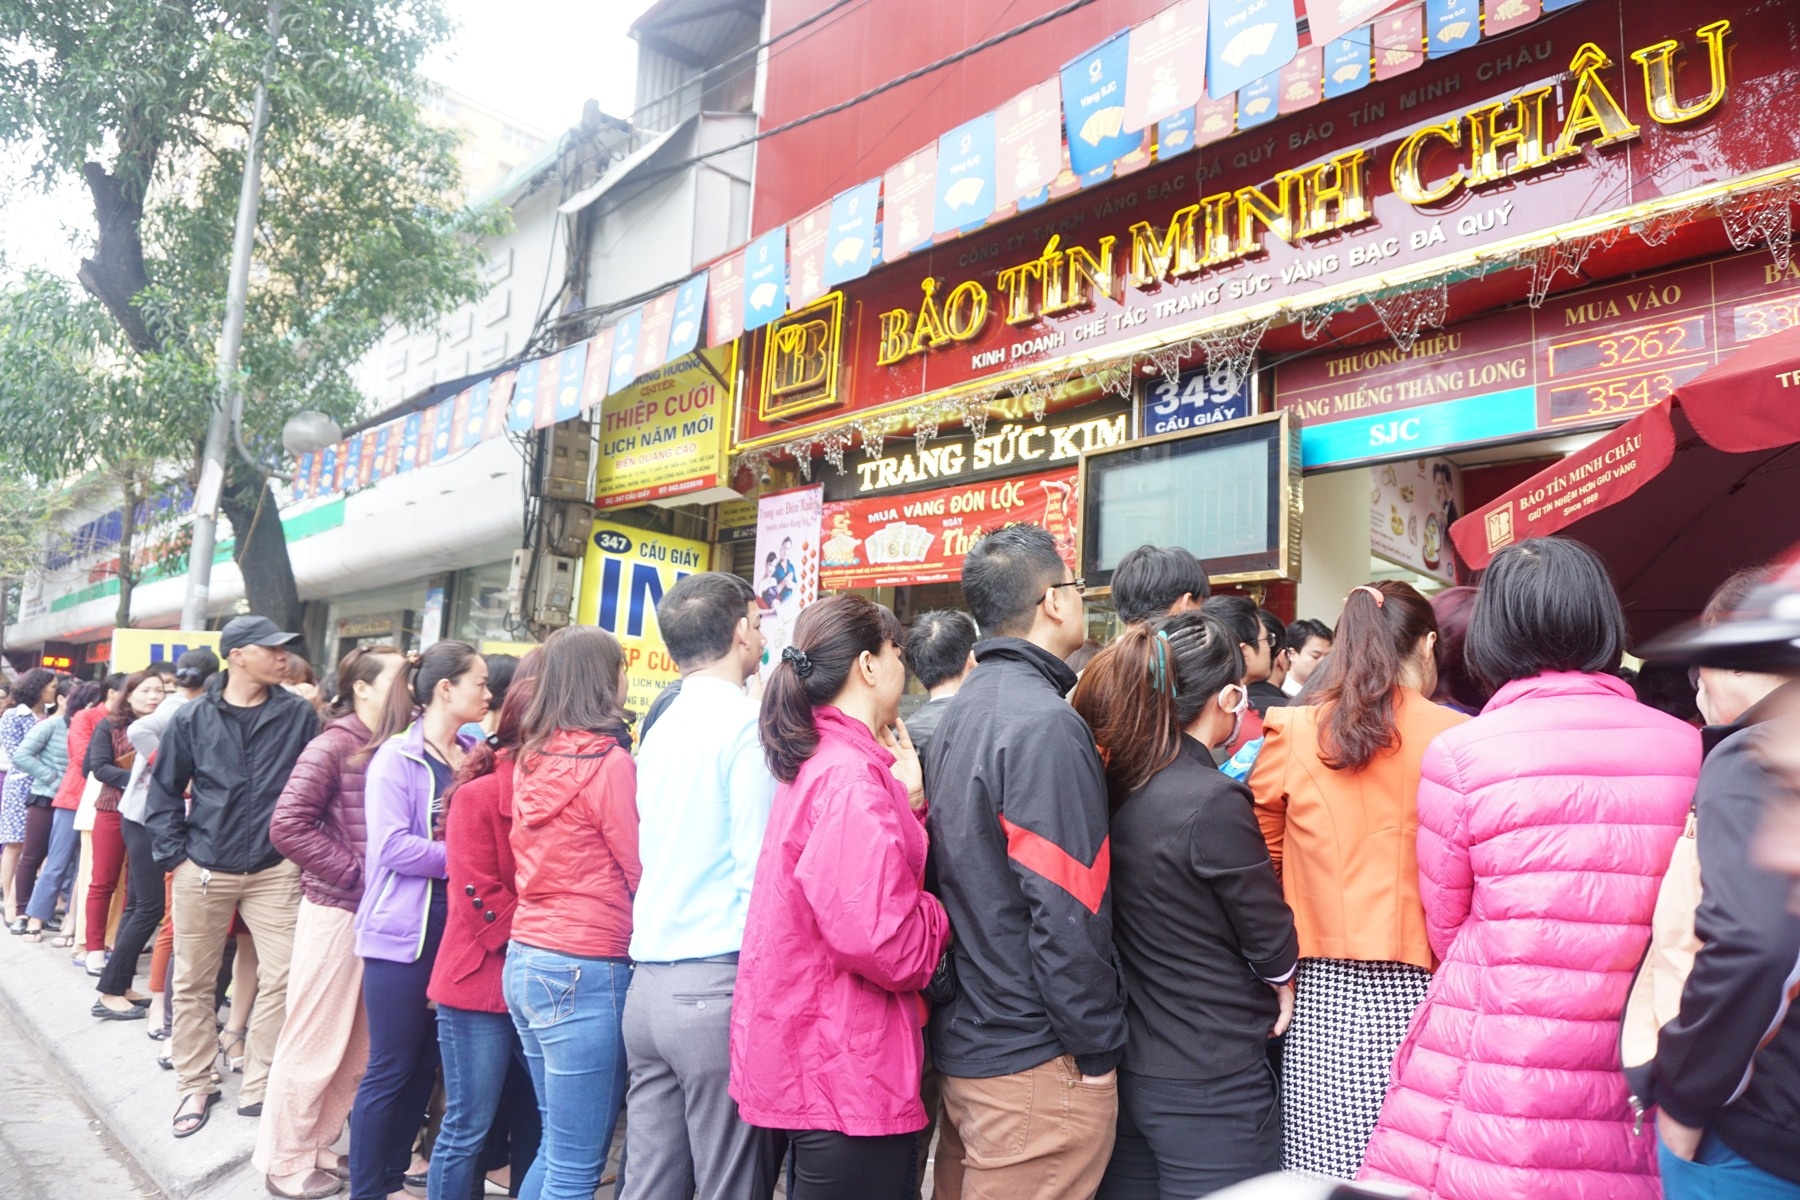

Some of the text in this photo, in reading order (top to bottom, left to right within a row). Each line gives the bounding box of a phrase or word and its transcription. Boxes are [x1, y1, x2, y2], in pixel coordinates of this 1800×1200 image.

[1080, 81, 1117, 107] Vàng SJC
[959, 243, 1000, 267] CÔNG
[1006, 231, 1027, 248] TY
[1093, 192, 1138, 219] VÀNG
[1150, 174, 1185, 202] BẠC
[1196, 160, 1222, 183] ĐÁ
[1233, 138, 1275, 168] QUÝ
[1289, 120, 1335, 149] BẢO
[1349, 100, 1386, 127] TÍN
[1399, 77, 1461, 110] MINH
[1476, 40, 1552, 81] CHÂU
[877, 20, 1730, 367] BẢO TÍN MINH CHÂU
[971, 199, 1515, 370] KINH DOANH CHẾ TÁC TRANG SỨC VÀNG BẠC ĐÁ QUÝ
[1564, 299, 1621, 327] MUA
[1626, 284, 1682, 313] VÀO
[1326, 332, 1462, 378] THƯƠNG HIỆU
[1598, 325, 1687, 368] 3262
[605, 381, 716, 432] THIỆP CƯỚI
[1154, 370, 1241, 415] 349
[1334, 382, 1393, 413] MIẾNG
[1397, 371, 1463, 401] THĂNG
[1468, 358, 1527, 388] LONG
[1587, 374, 1674, 415] 3543
[604, 413, 715, 459] LỊCH NĂM MỚI
[1155, 405, 1236, 434] CẦU GIẤY
[1369, 418, 1421, 446] SJC
[857, 413, 1127, 492] TRANG SỨC KIM
[1519, 433, 1642, 511] BẢO TÍN MINH CHÂU
[1613, 460, 1637, 478] VÀNG
[868, 481, 1025, 524] MUA VÀNG ĐÓN LỘC
[1563, 492, 1598, 517] Since 1989
[600, 533, 700, 568] 347 CẦU GIẤY
[598, 557, 691, 637] IN
